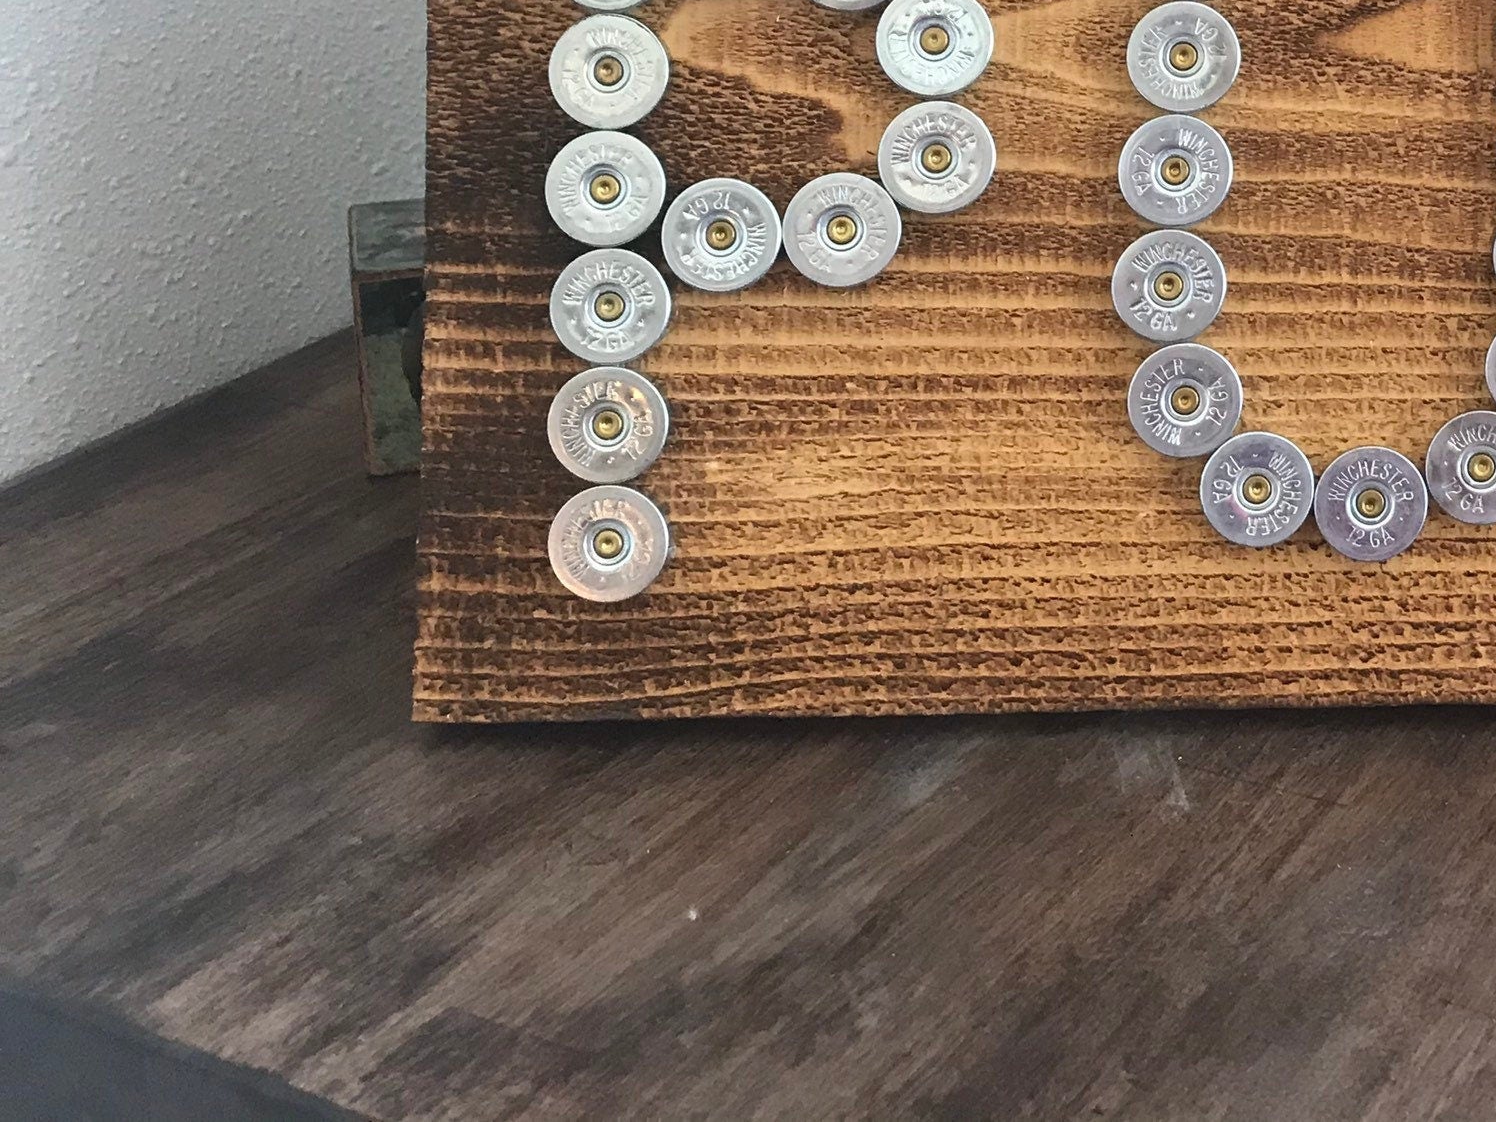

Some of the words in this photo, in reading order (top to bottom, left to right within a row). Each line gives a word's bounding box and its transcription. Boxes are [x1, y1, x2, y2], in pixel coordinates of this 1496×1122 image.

[1176, 127, 1219, 213] WINCHESTER
[1142, 356, 1184, 443] WINCHESTER
[1208, 378, 1229, 403] GA
[1205, 405, 1228, 429] 12
[1219, 452, 1243, 476] 12
[1214, 473, 1233, 498] GA
[1247, 448, 1300, 532] WINCHESTER
[1328, 459, 1414, 501] WINCHESTER
[1343, 522, 1366, 545] 12
[1369, 525, 1393, 546] GA
